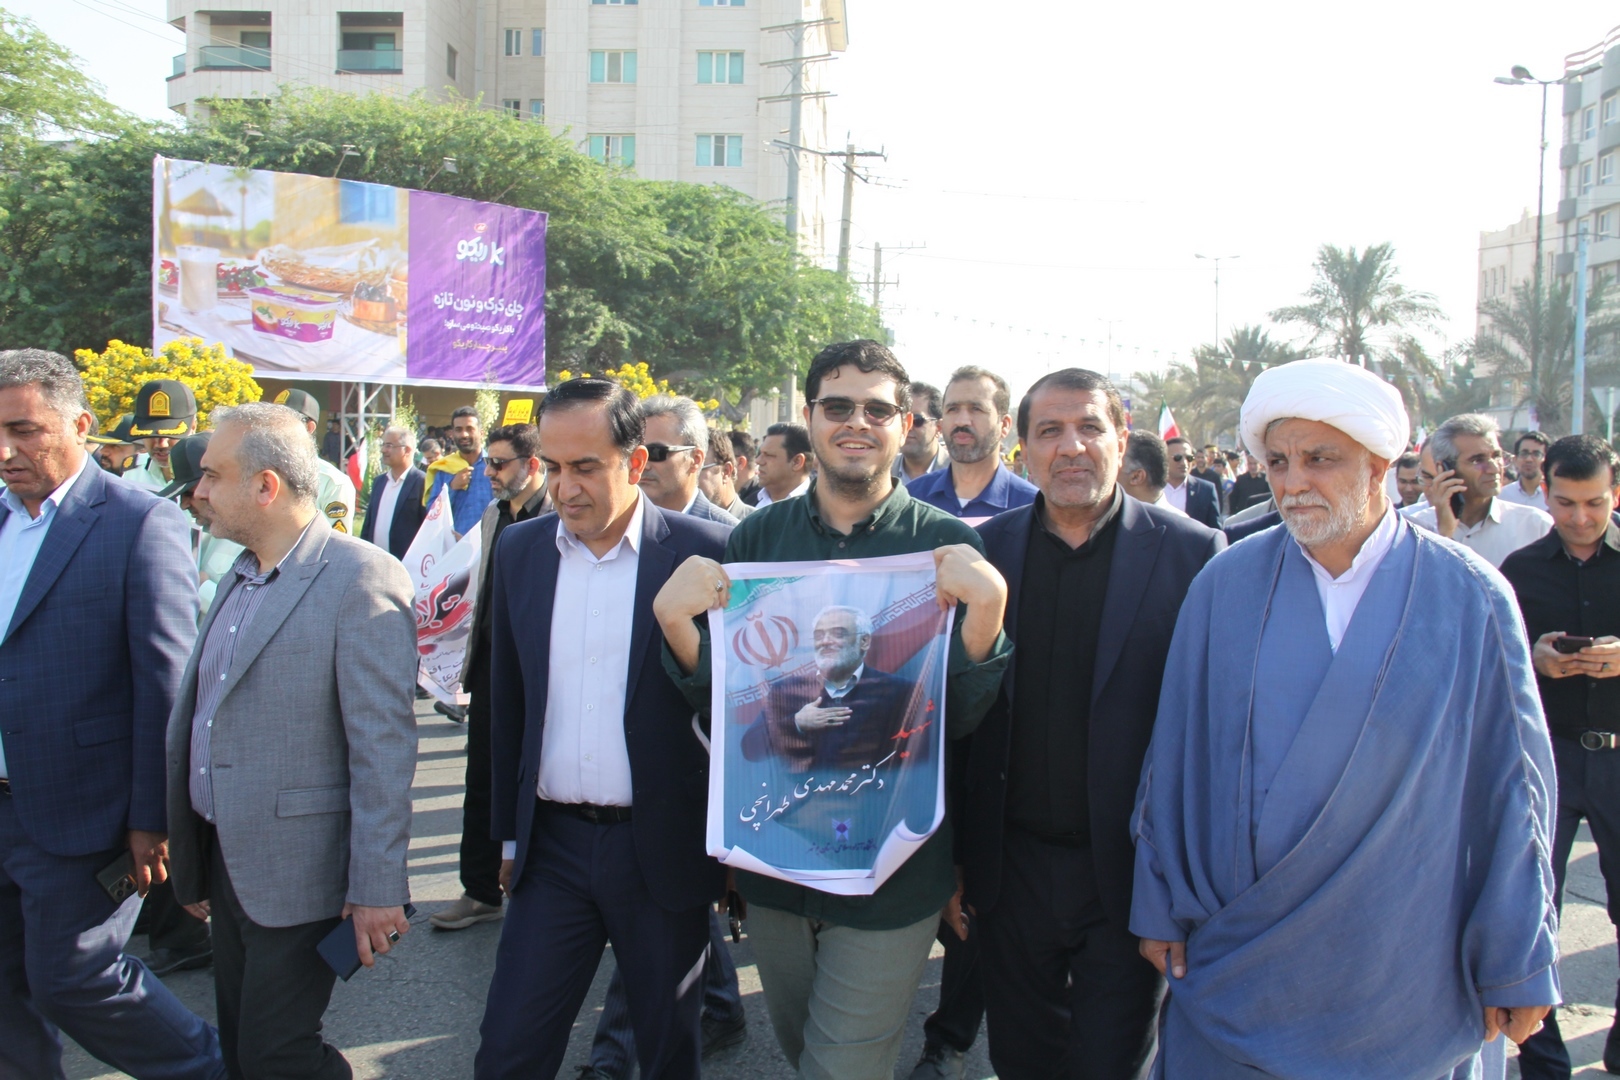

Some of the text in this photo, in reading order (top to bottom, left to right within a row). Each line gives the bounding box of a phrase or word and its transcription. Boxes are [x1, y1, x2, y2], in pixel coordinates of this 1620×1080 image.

[433, 292, 524, 320] چای کرک و نون تازه
[889, 698, 935, 759] شهید
[793, 750, 897, 799] دکتر محمد مهدی
[739, 782, 790, 831] طهرانچی
